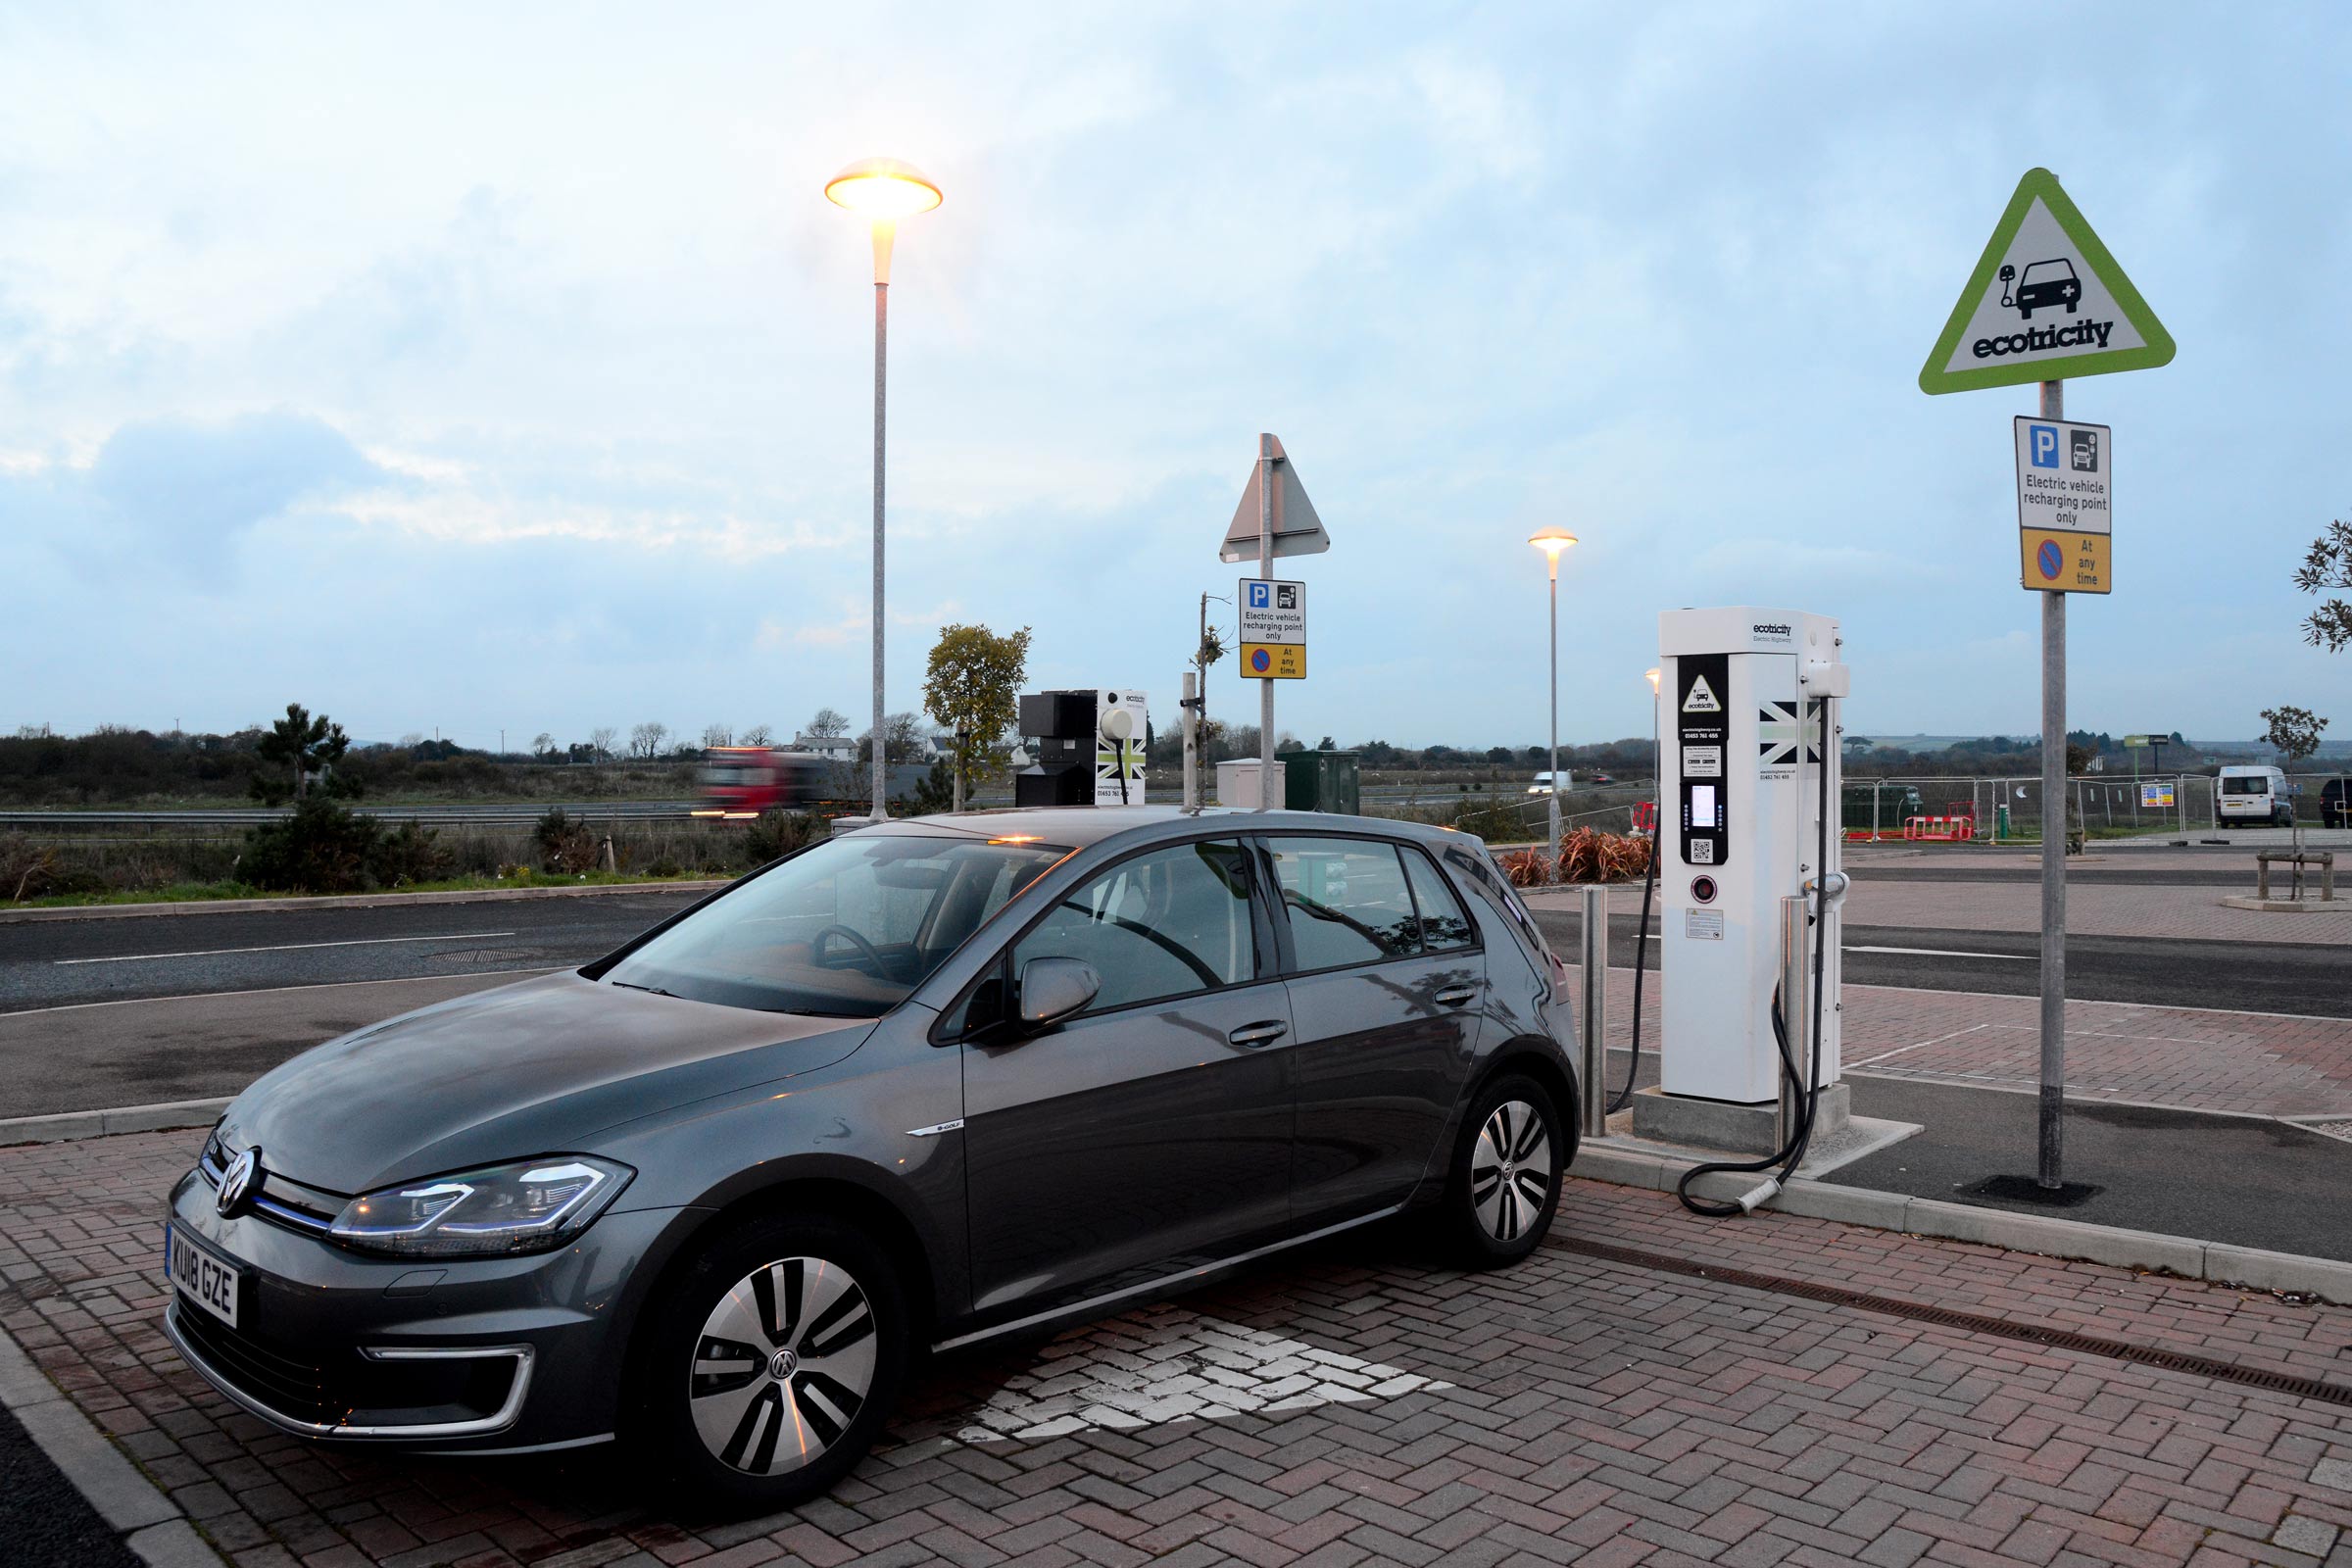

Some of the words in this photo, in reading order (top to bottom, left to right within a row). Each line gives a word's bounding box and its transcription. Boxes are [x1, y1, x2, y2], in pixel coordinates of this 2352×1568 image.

[1973, 318, 2113, 358] ecotricity
[2036, 430, 2055, 464] P
[2026, 474, 2067, 490] Electric
[2070, 479, 2104, 494] vehicle
[2024, 492, 2079, 510] recharging
[2082, 496, 2107, 511] point
[2056, 511, 2078, 525] only
[2082, 539, 2092, 553] At
[2079, 558, 2095, 570] any
[2077, 571, 2097, 585] time
[1253, 586, 1266, 606] P
[1246, 612, 1274, 620] Electric
[1244, 621, 1282, 631] recharging
[1753, 623, 1791, 636] ecotricity
[173, 1235, 198, 1292] KU18
[202, 1258, 232, 1315] GZE
